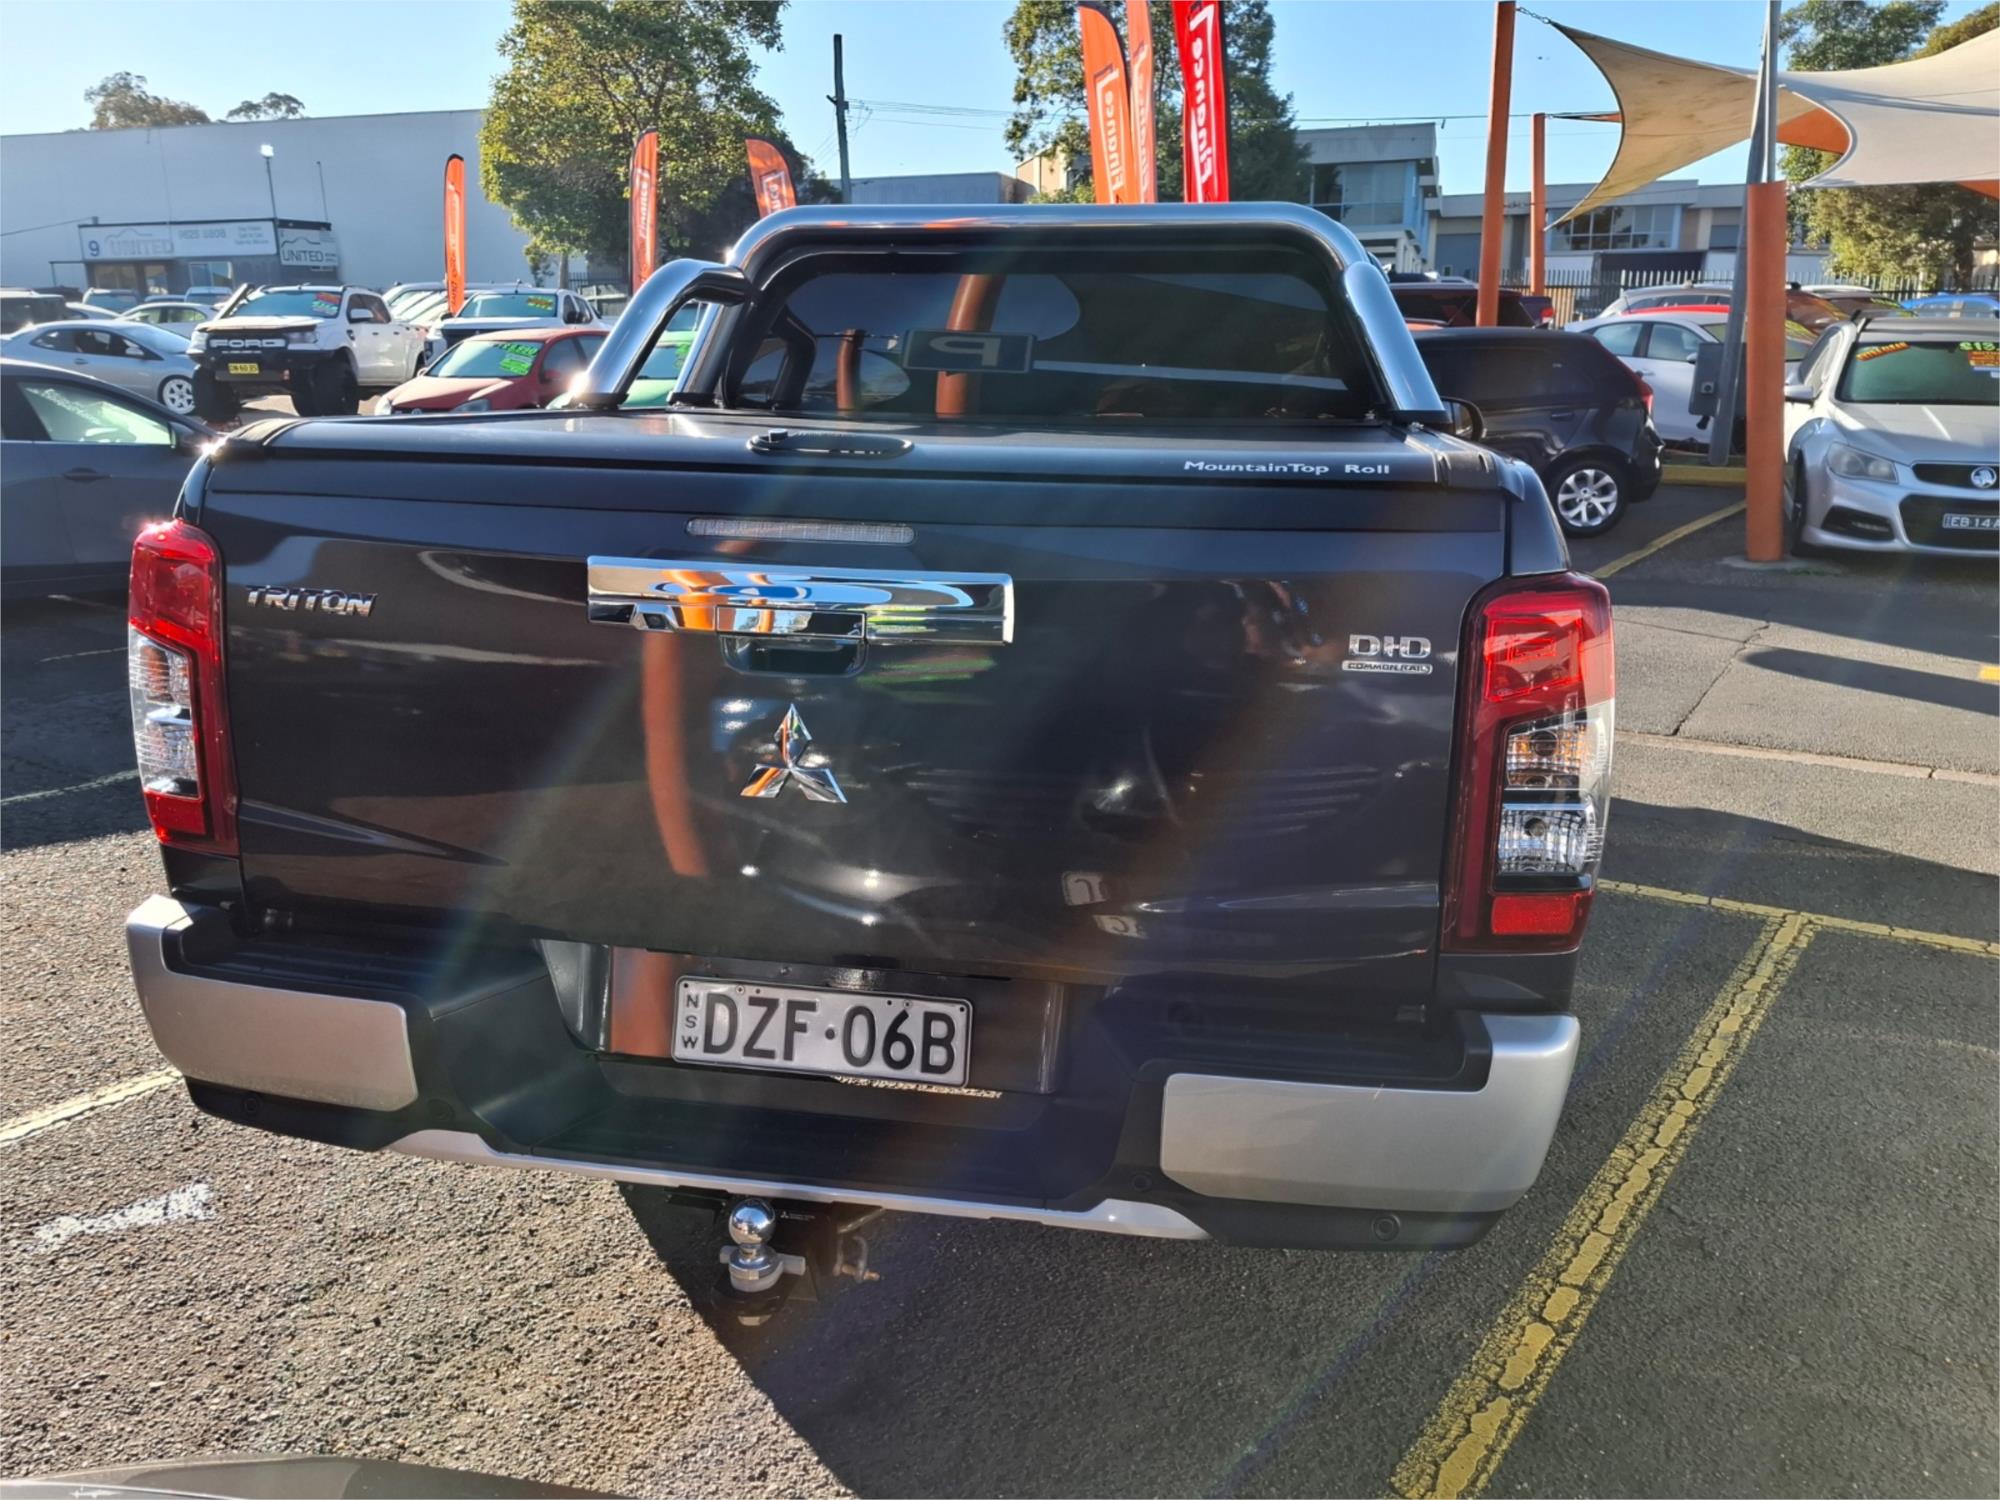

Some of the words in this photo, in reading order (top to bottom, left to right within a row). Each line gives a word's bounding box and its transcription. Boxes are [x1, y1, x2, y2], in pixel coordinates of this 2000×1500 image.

[88, 240, 100, 257] 9
[282, 250, 324, 262] UNITED
[208, 337, 286, 349] FORD
[1184, 460, 1330, 476] MountainTop
[1344, 464, 1390, 475] Roll
[246, 585, 378, 618] TRITON
[1347, 662, 1398, 672] COMMON
